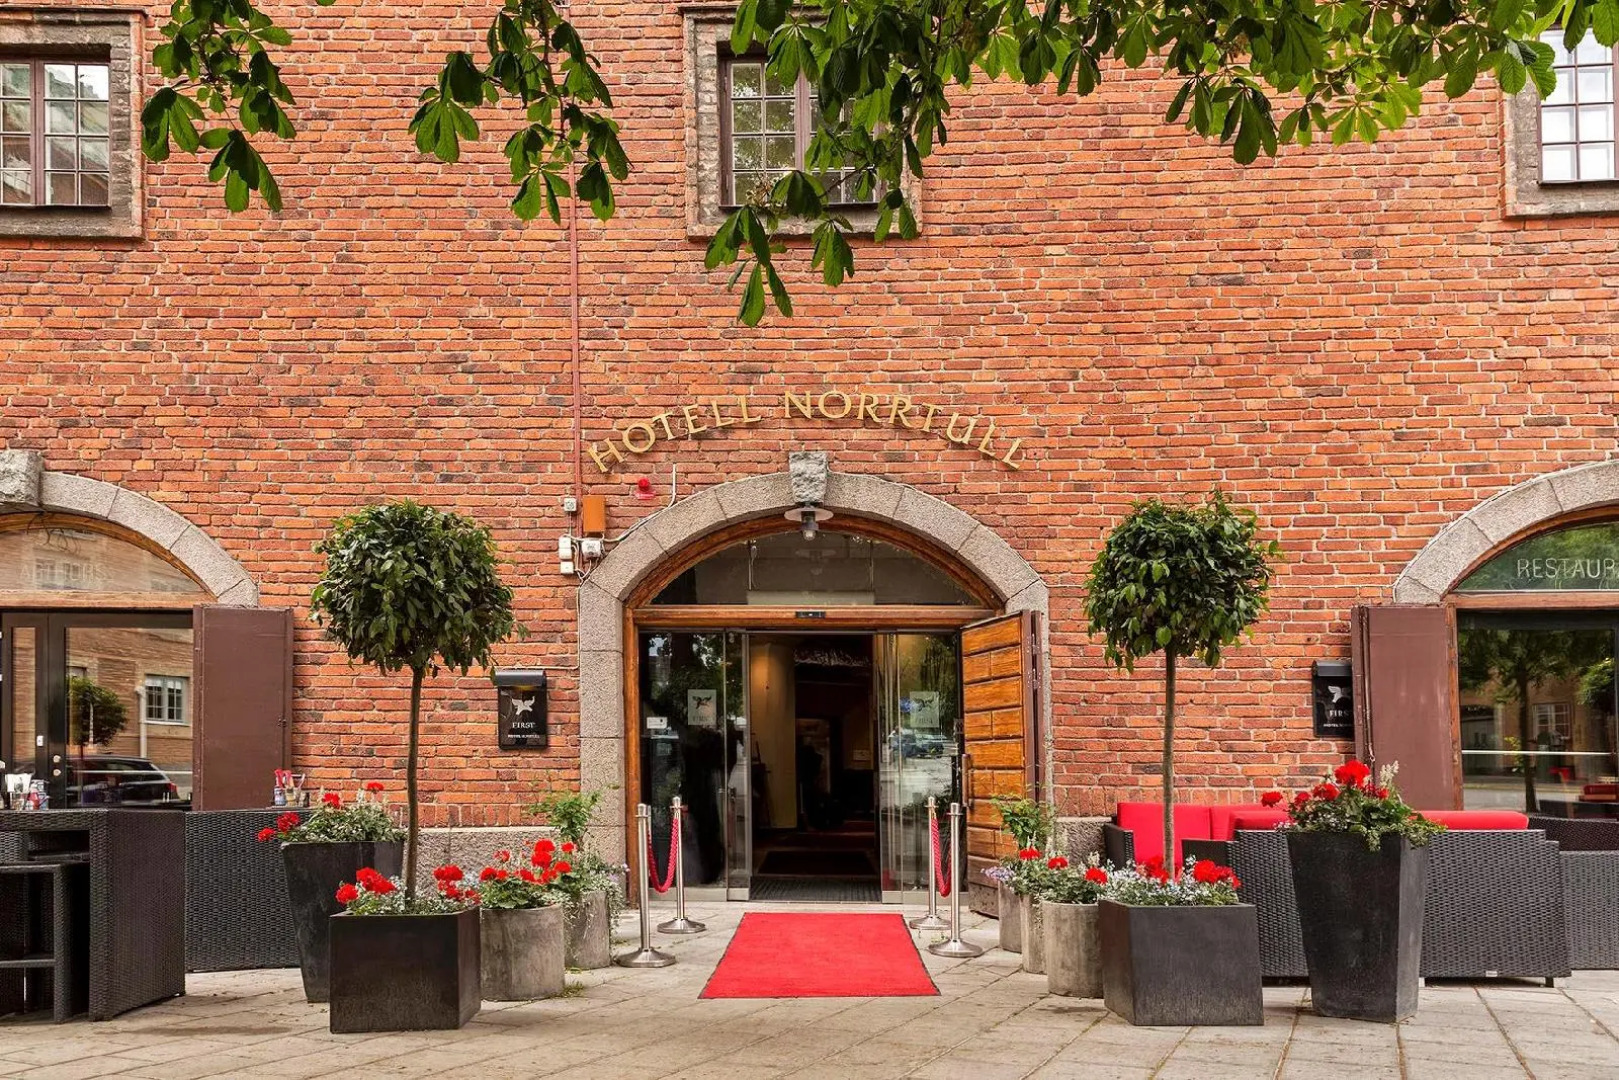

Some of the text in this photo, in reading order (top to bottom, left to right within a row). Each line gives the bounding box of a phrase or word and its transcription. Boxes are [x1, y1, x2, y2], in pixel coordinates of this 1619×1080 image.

[587, 390, 1026, 473] HOTELL NORRTULL
[1517, 557, 1619, 579] RESTAUR
